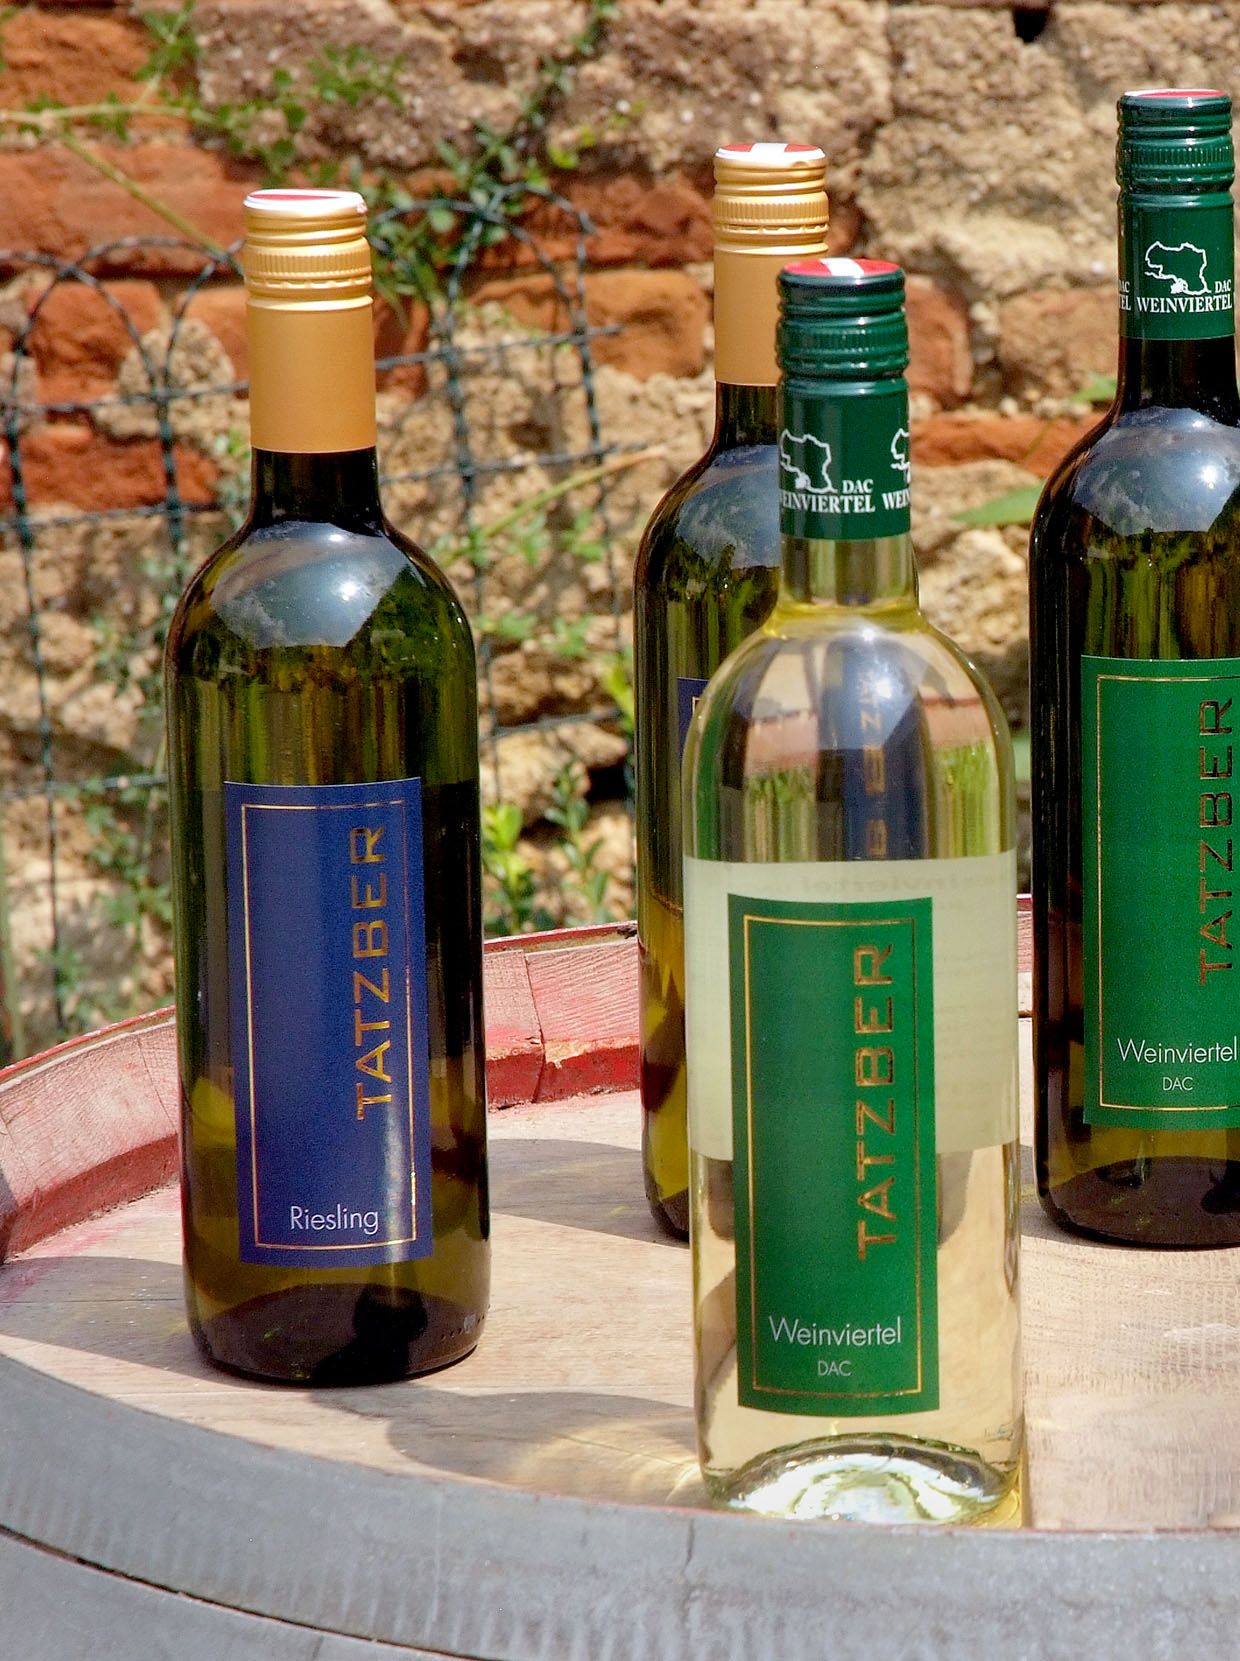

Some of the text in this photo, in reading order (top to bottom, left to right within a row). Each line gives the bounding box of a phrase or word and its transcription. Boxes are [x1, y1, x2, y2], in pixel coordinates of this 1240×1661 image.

[1214, 279, 1232, 293] DAC
[1136, 293, 1233, 313] WEINVIERTEL
[842, 478, 874, 494] DAC
[780, 488, 876, 513] EINVIERTEL
[1200, 697, 1233, 986] TATZBER
[349, 825, 392, 1120] TATZBER
[1117, 1035, 1239, 1064] Weinviertel
[1162, 1076, 1194, 1092] DAC
[853, 943, 897, 1261] TATZBER
[290, 1204, 380, 1235] Riesling
[768, 1315, 902, 1347] Weinviertel
[817, 1361, 852, 1378] DAC
